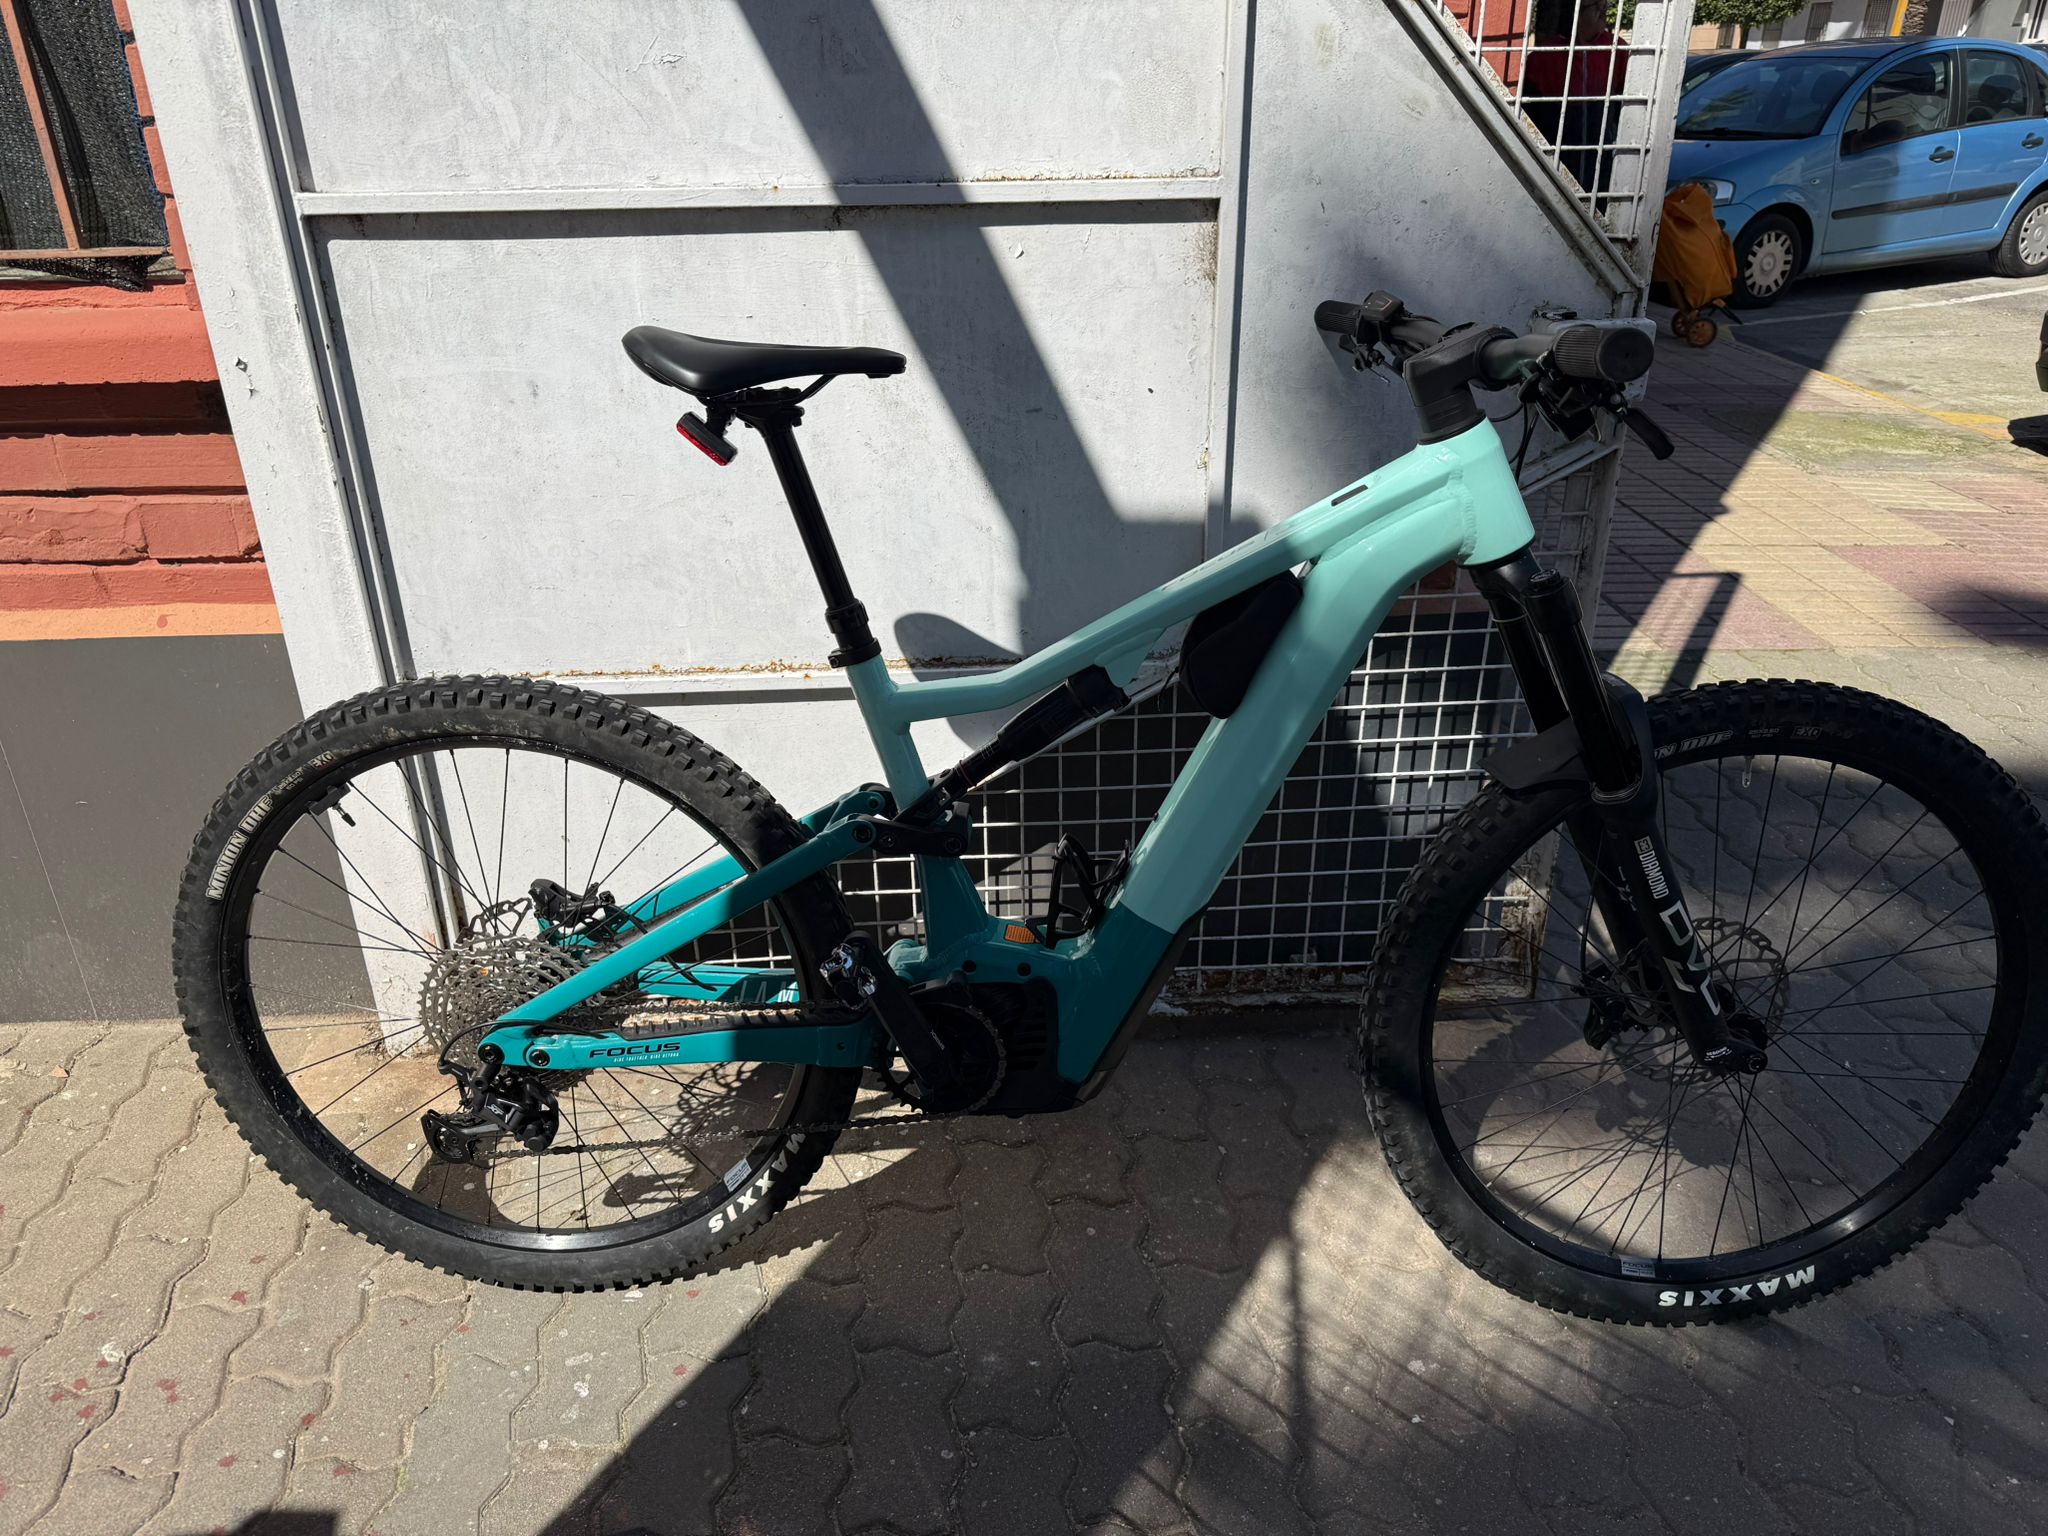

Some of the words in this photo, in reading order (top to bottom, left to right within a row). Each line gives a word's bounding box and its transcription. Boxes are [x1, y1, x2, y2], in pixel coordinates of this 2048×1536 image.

[206, 830, 248, 900] MINION
[1639, 850, 1670, 900] DIAMOND
[589, 1042, 681, 1059] FOCUS
[708, 1133, 807, 1234] MAXXIS
[1658, 1265, 1816, 1307] MAXXIS
